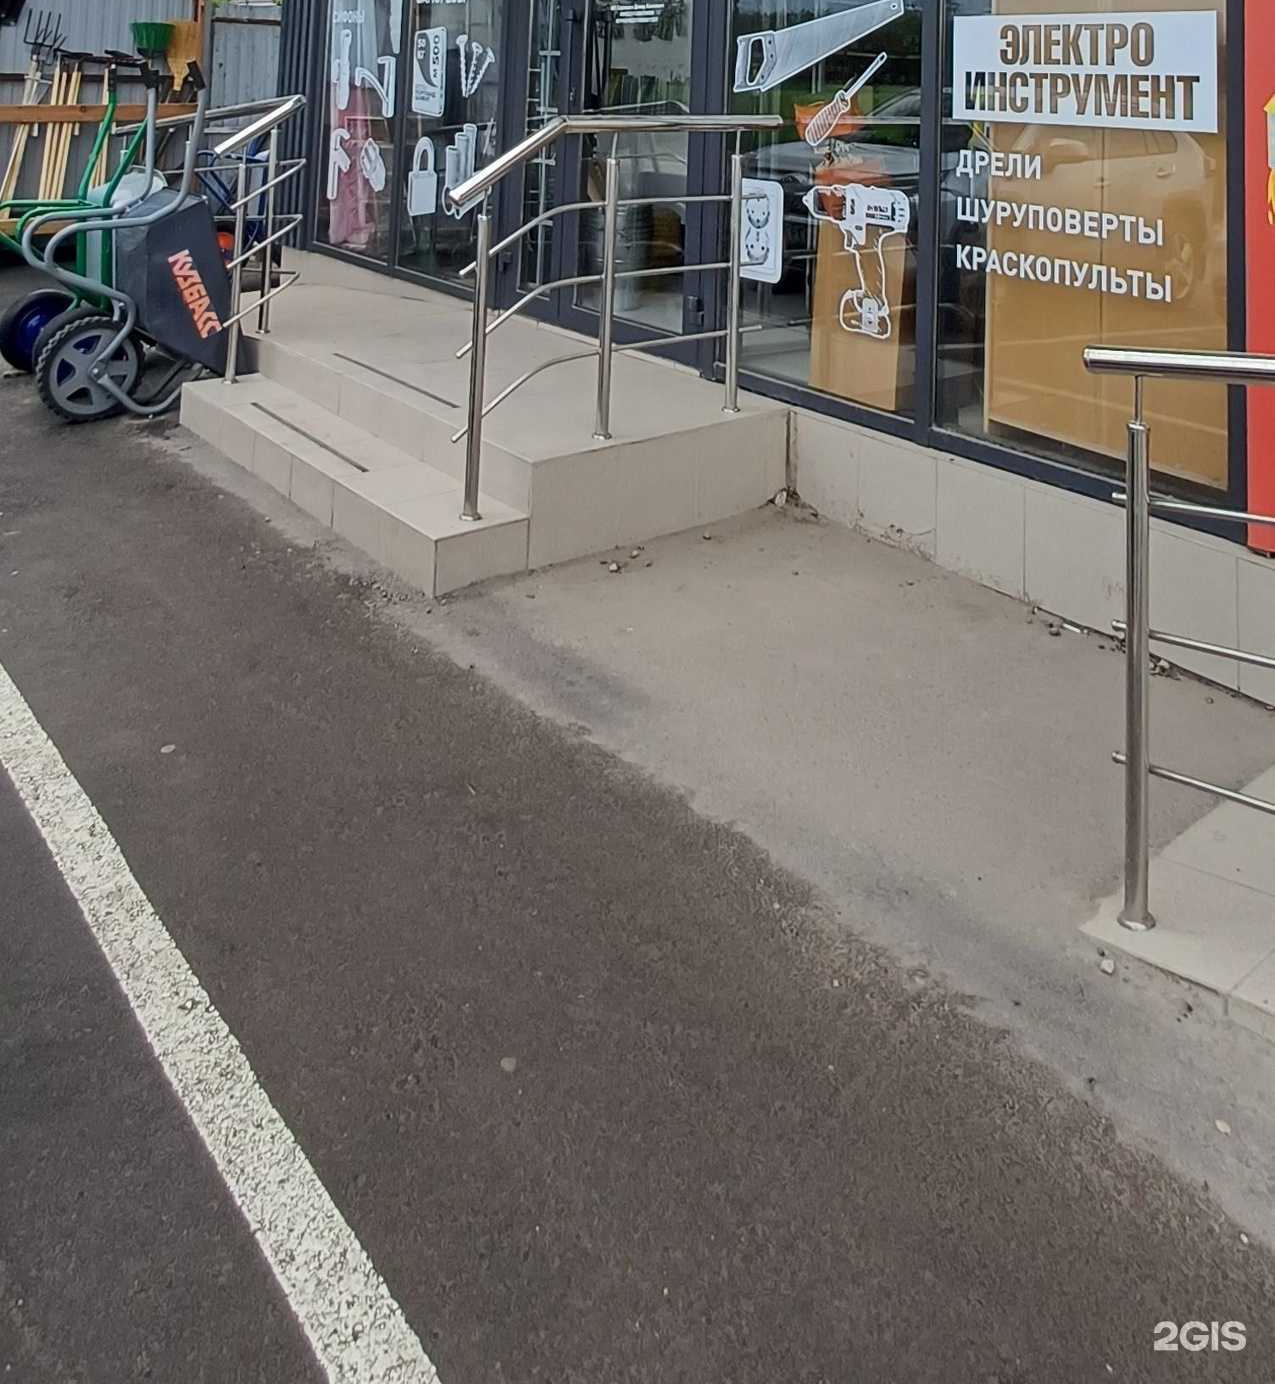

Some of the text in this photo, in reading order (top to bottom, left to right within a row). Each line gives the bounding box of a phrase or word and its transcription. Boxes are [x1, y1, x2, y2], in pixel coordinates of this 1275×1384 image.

[999, 22, 1155, 66] ЭЛЕКТРО
[965, 71, 1201, 121] ИНСТРУМЕНТ
[956, 149, 1042, 180] ДРЕЛИ
[956, 196, 1164, 246] ШУРУПОВЕРТЫ
[167, 249, 222, 338] КУЗБАСС
[956, 244, 1172, 303] КРАСКОПУЛЬТЫ
